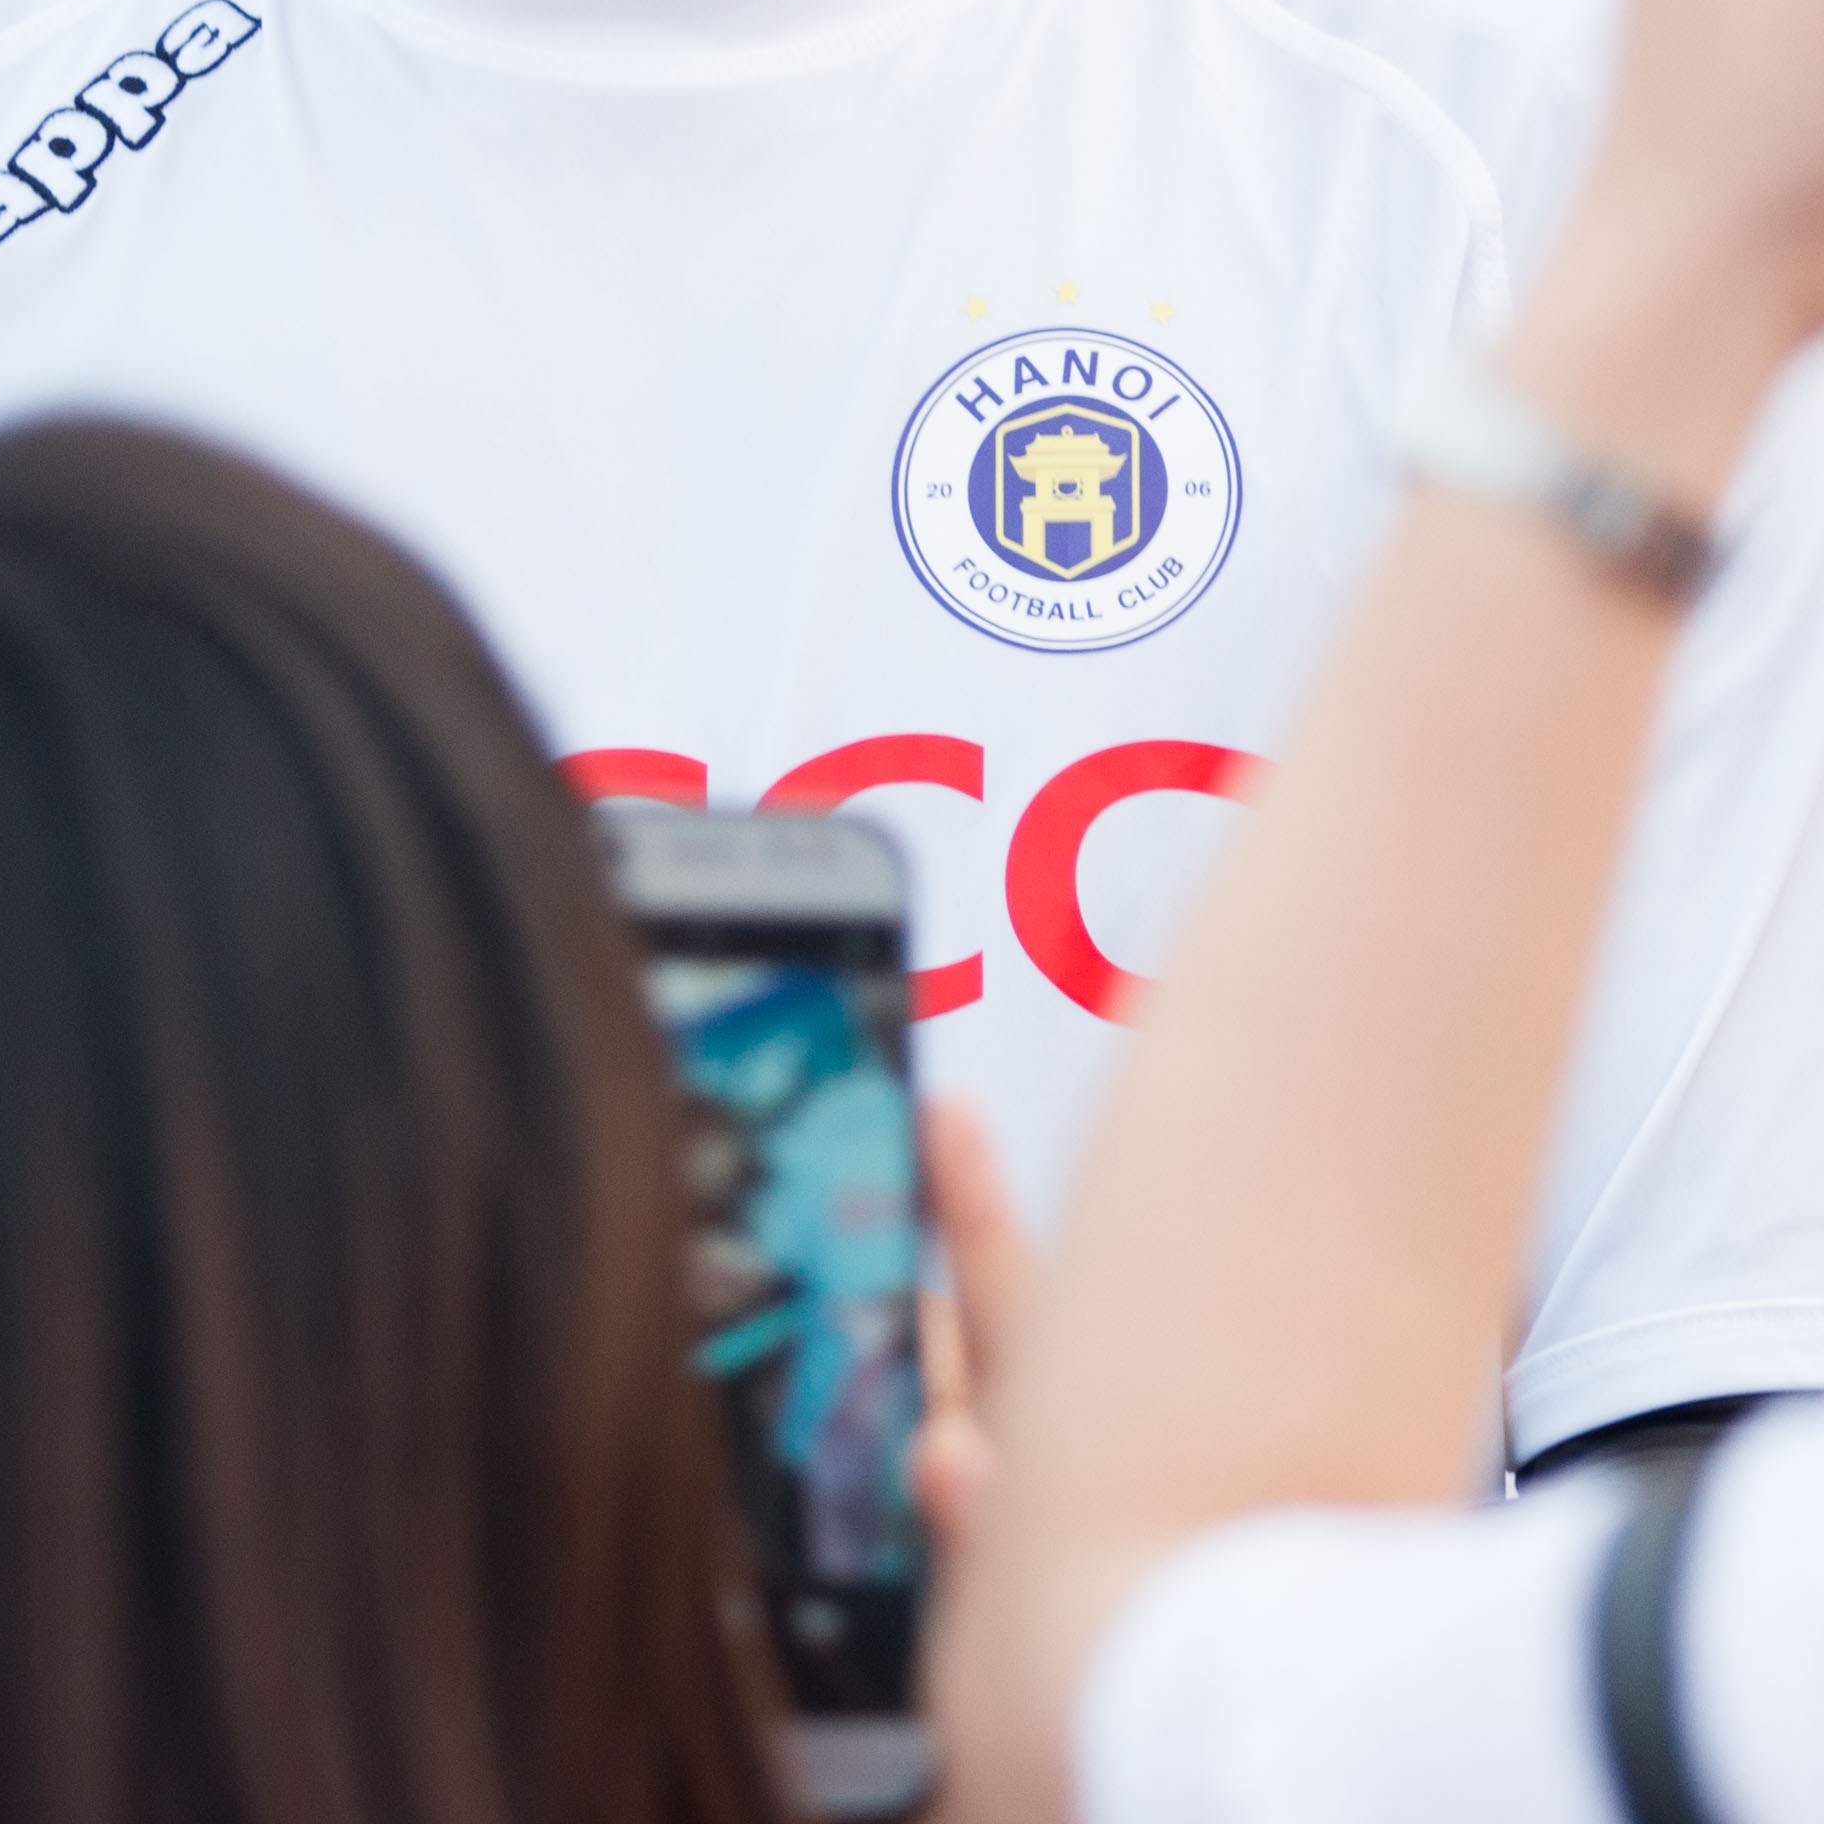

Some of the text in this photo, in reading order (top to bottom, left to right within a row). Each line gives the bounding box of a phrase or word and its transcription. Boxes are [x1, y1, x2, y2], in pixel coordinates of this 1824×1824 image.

[954, 348, 1181, 423] HANOI
[925, 480, 1212, 499] 20 06
[952, 556, 1185, 621] FOOTBALL CLUB
